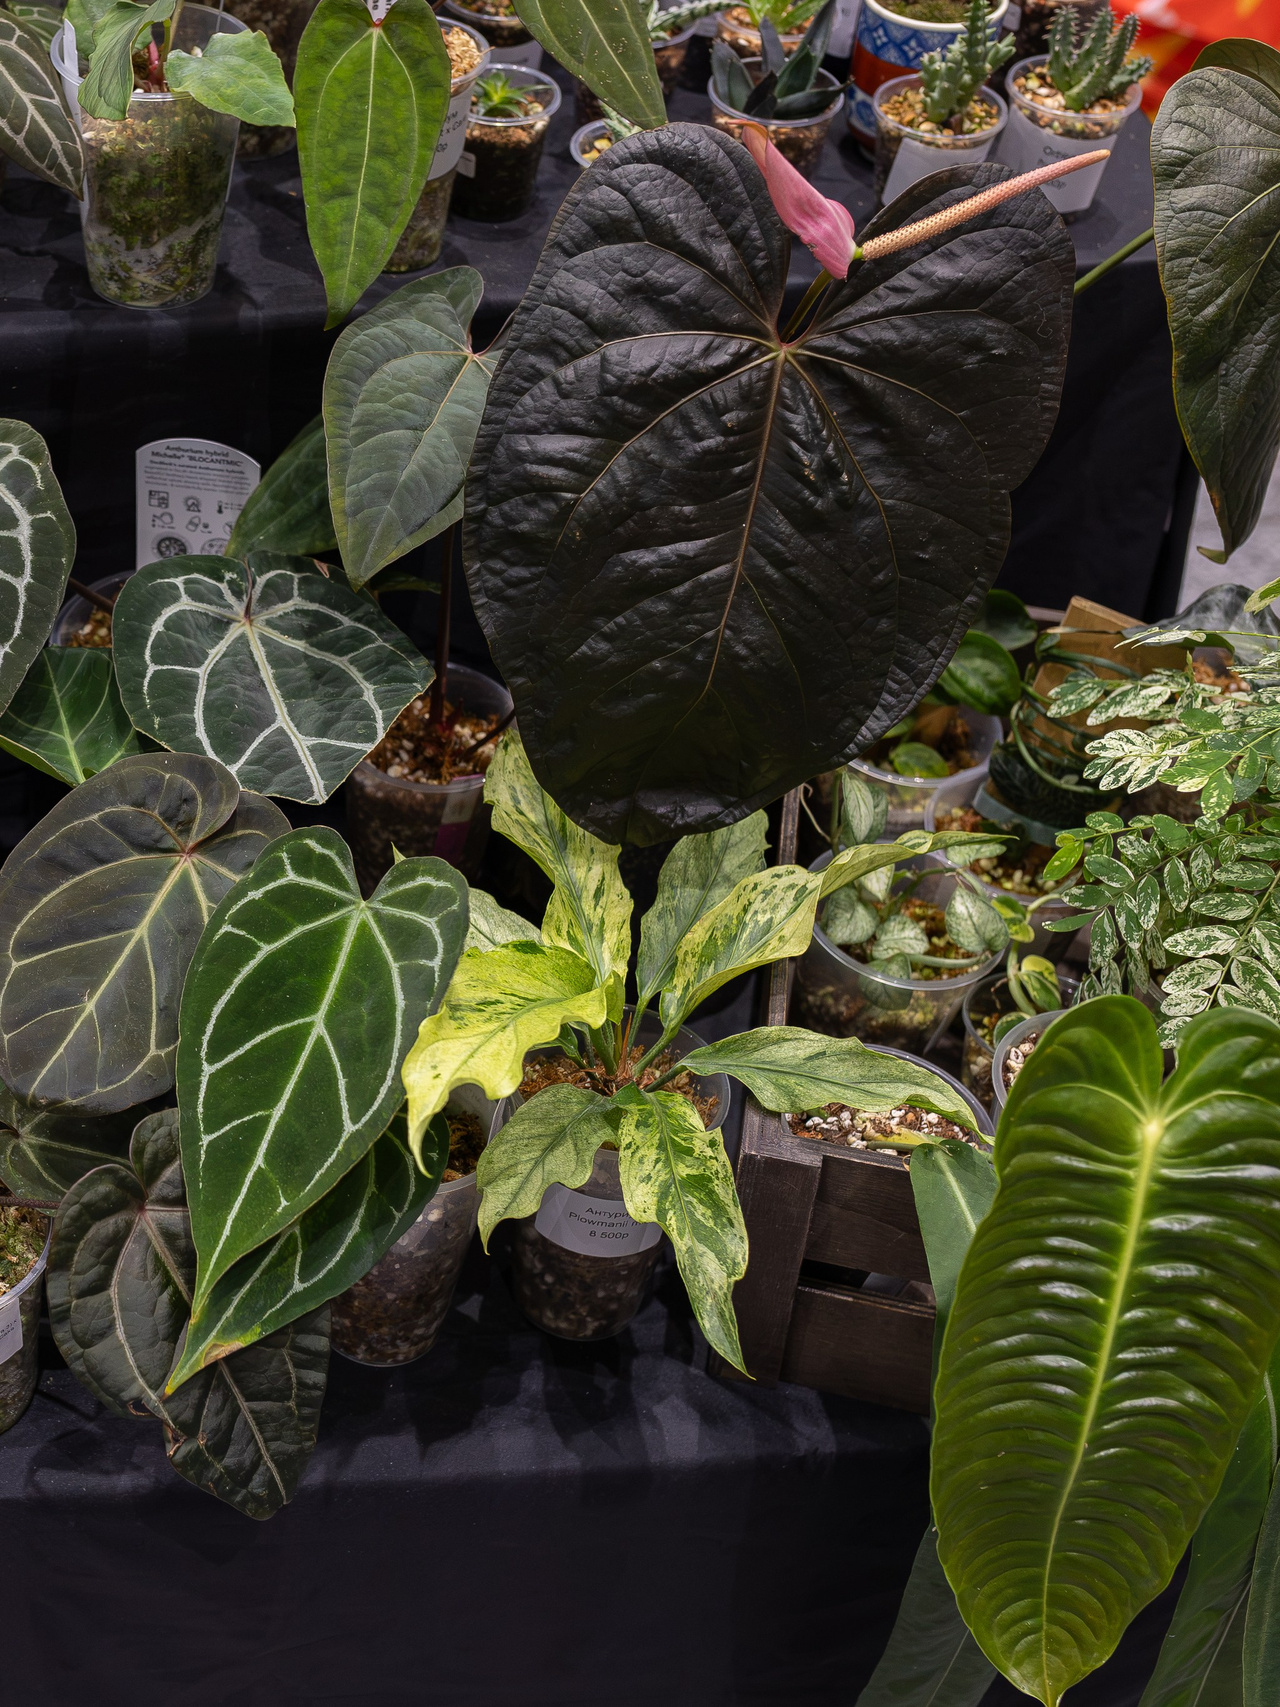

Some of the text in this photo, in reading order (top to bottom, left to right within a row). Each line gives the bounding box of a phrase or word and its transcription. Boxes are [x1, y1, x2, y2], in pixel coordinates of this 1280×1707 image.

[585, 1207, 631, 1219] Антури
[569, 1211, 628, 1228] Plowmanii
[589, 1229, 630, 1241] 8 500р
